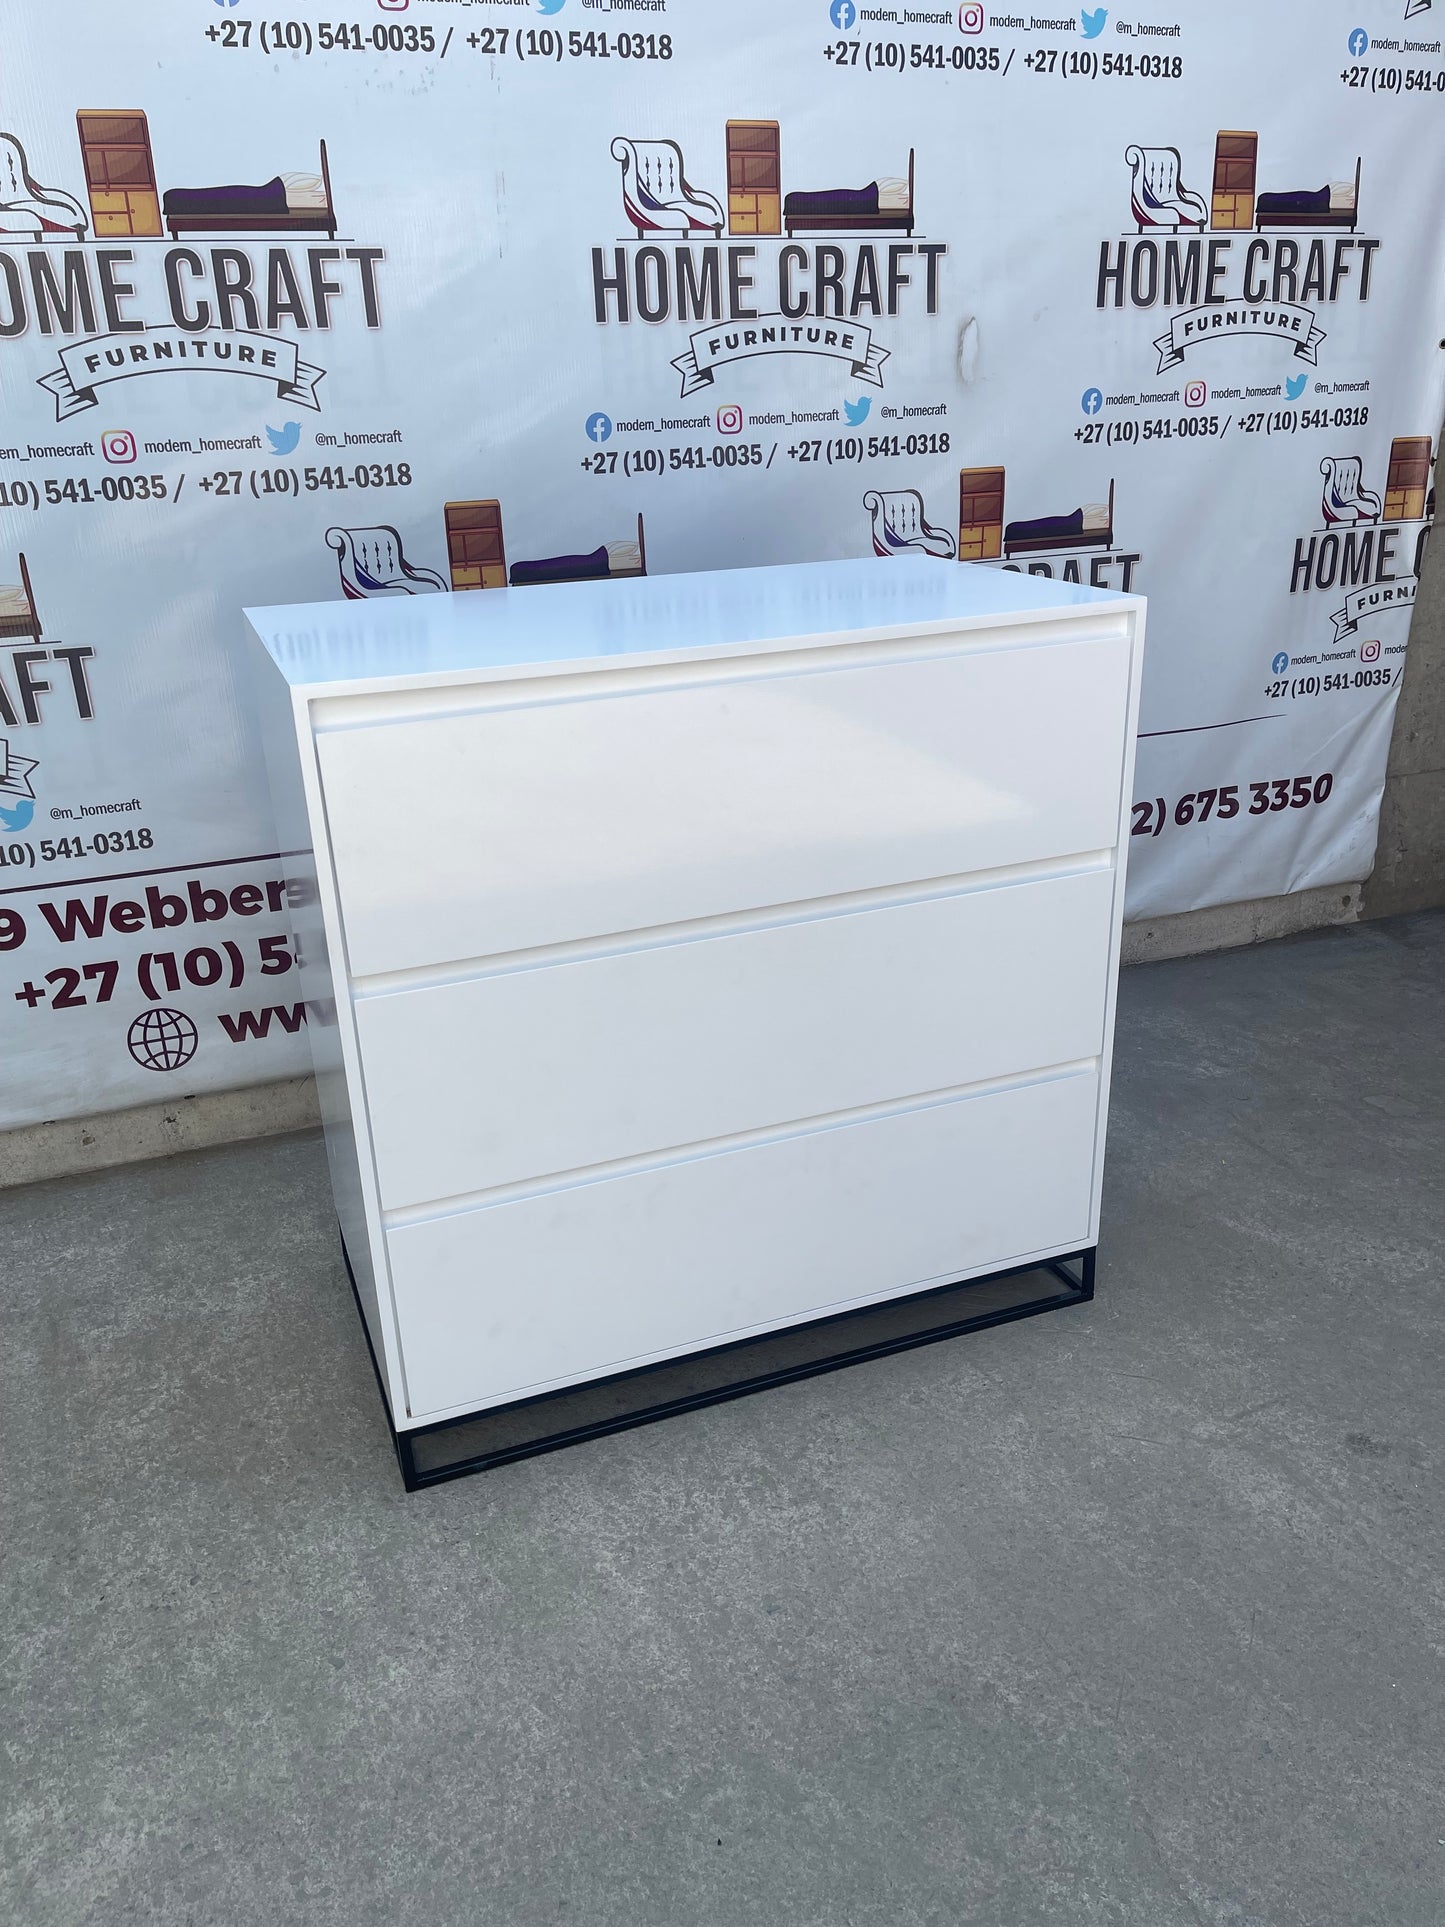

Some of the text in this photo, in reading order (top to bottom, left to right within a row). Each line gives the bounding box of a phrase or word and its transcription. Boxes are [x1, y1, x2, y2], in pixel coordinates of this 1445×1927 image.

[205, 21, 252, 48] +27
[259, 22, 312, 55] (10)
[319, 24, 436, 52] 541-0035
[466, 28, 509, 54] +27
[515, 29, 563, 61] (10)
[569, 30, 673, 60] 541-0318
[1116, 20, 1181, 38] @m_homecraft
[823, 41, 860, 66] +27
[865, 42, 905, 73] (10)
[910, 44, 1000, 71] 541-0035
[1023, 50, 1057, 73] +27
[1061, 51, 1098, 80] (10)
[1101, 53, 1183, 79] 541-0318
[1340, 66, 1369, 87] +27
[1371, 67, 1402, 94] (10)
[164, 247, 384, 332] CRAFT
[591, 244, 947, 322] HOME CRAFT
[1096, 239, 1380, 308] HOME CRAFT
[709, 327, 854, 355] FURNITURE
[1184, 311, 1302, 336] FURNITURE
[84, 341, 277, 373] FURNITURE
[1315, 380, 1370, 394] @m_homecraft
[881, 404, 947, 420] @m_homecraft
[1074, 424, 1103, 444] +27
[1107, 422, 1139, 446] (10)
[1143, 416, 1218, 440] 541-0035
[1238, 413, 1265, 433] +27
[1267, 411, 1298, 435] (10)
[1301, 407, 1368, 429] 541-0318
[316, 430, 402, 447] @m_homecraft
[581, 452, 618, 475] +27
[624, 450, 665, 477] (10)
[669, 444, 762, 470] 541-0035
[788, 441, 822, 463] +27
[827, 438, 864, 465] (10)
[868, 433, 950, 458] 541-0318
[45, 475, 167, 504] 541-0035
[199, 472, 243, 498] +27
[250, 469, 299, 498] (10)
[304, 463, 412, 491] 541-0318
[1290, 529, 1399, 592] HOME
[1265, 680, 1289, 698] +27
[1291, 677, 1320, 698] (10)
[1323, 668, 1391, 691] 541-0035
[50, 799, 141, 820] @m_homecraft
[1175, 785, 1239, 826] 675
[1249, 773, 1333, 815] 3350
[40, 828, 154, 862] 541-0318
[15, 961, 119, 1009] +27
[138, 941, 244, 1000] (10)
